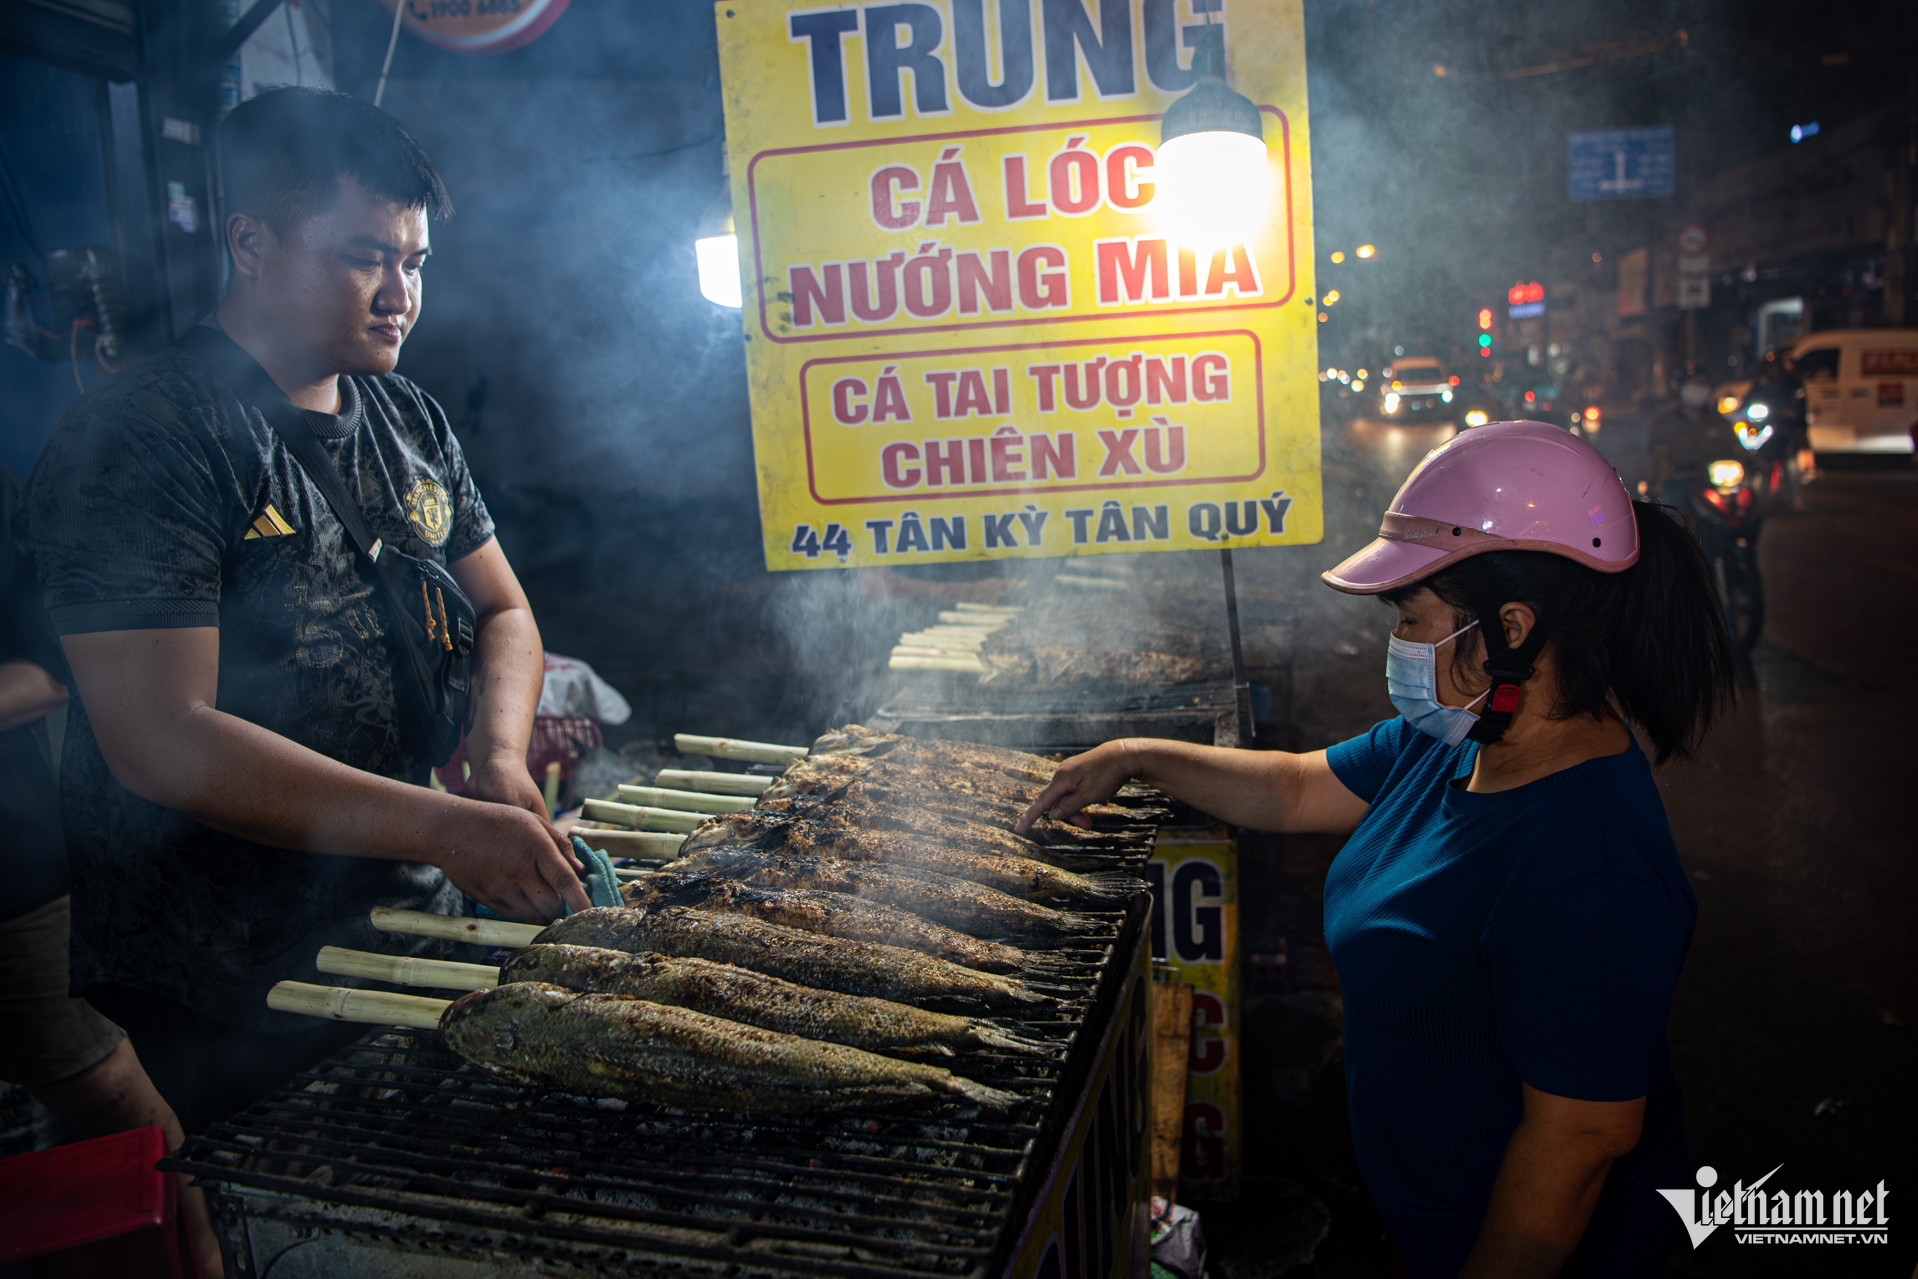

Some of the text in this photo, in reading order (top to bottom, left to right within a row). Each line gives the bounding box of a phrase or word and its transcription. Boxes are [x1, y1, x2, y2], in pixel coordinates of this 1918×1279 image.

[870, 136, 1159, 231] CÁ LÓC
[789, 243, 1069, 328] NƯỚNG
[831, 353, 1231, 425] CÁ TAI TƯỢNG
[881, 418, 1187, 489] CHIÊN XÙ
[792, 491, 1292, 558] 44 TÂN KỲ TÂN QUÝ
